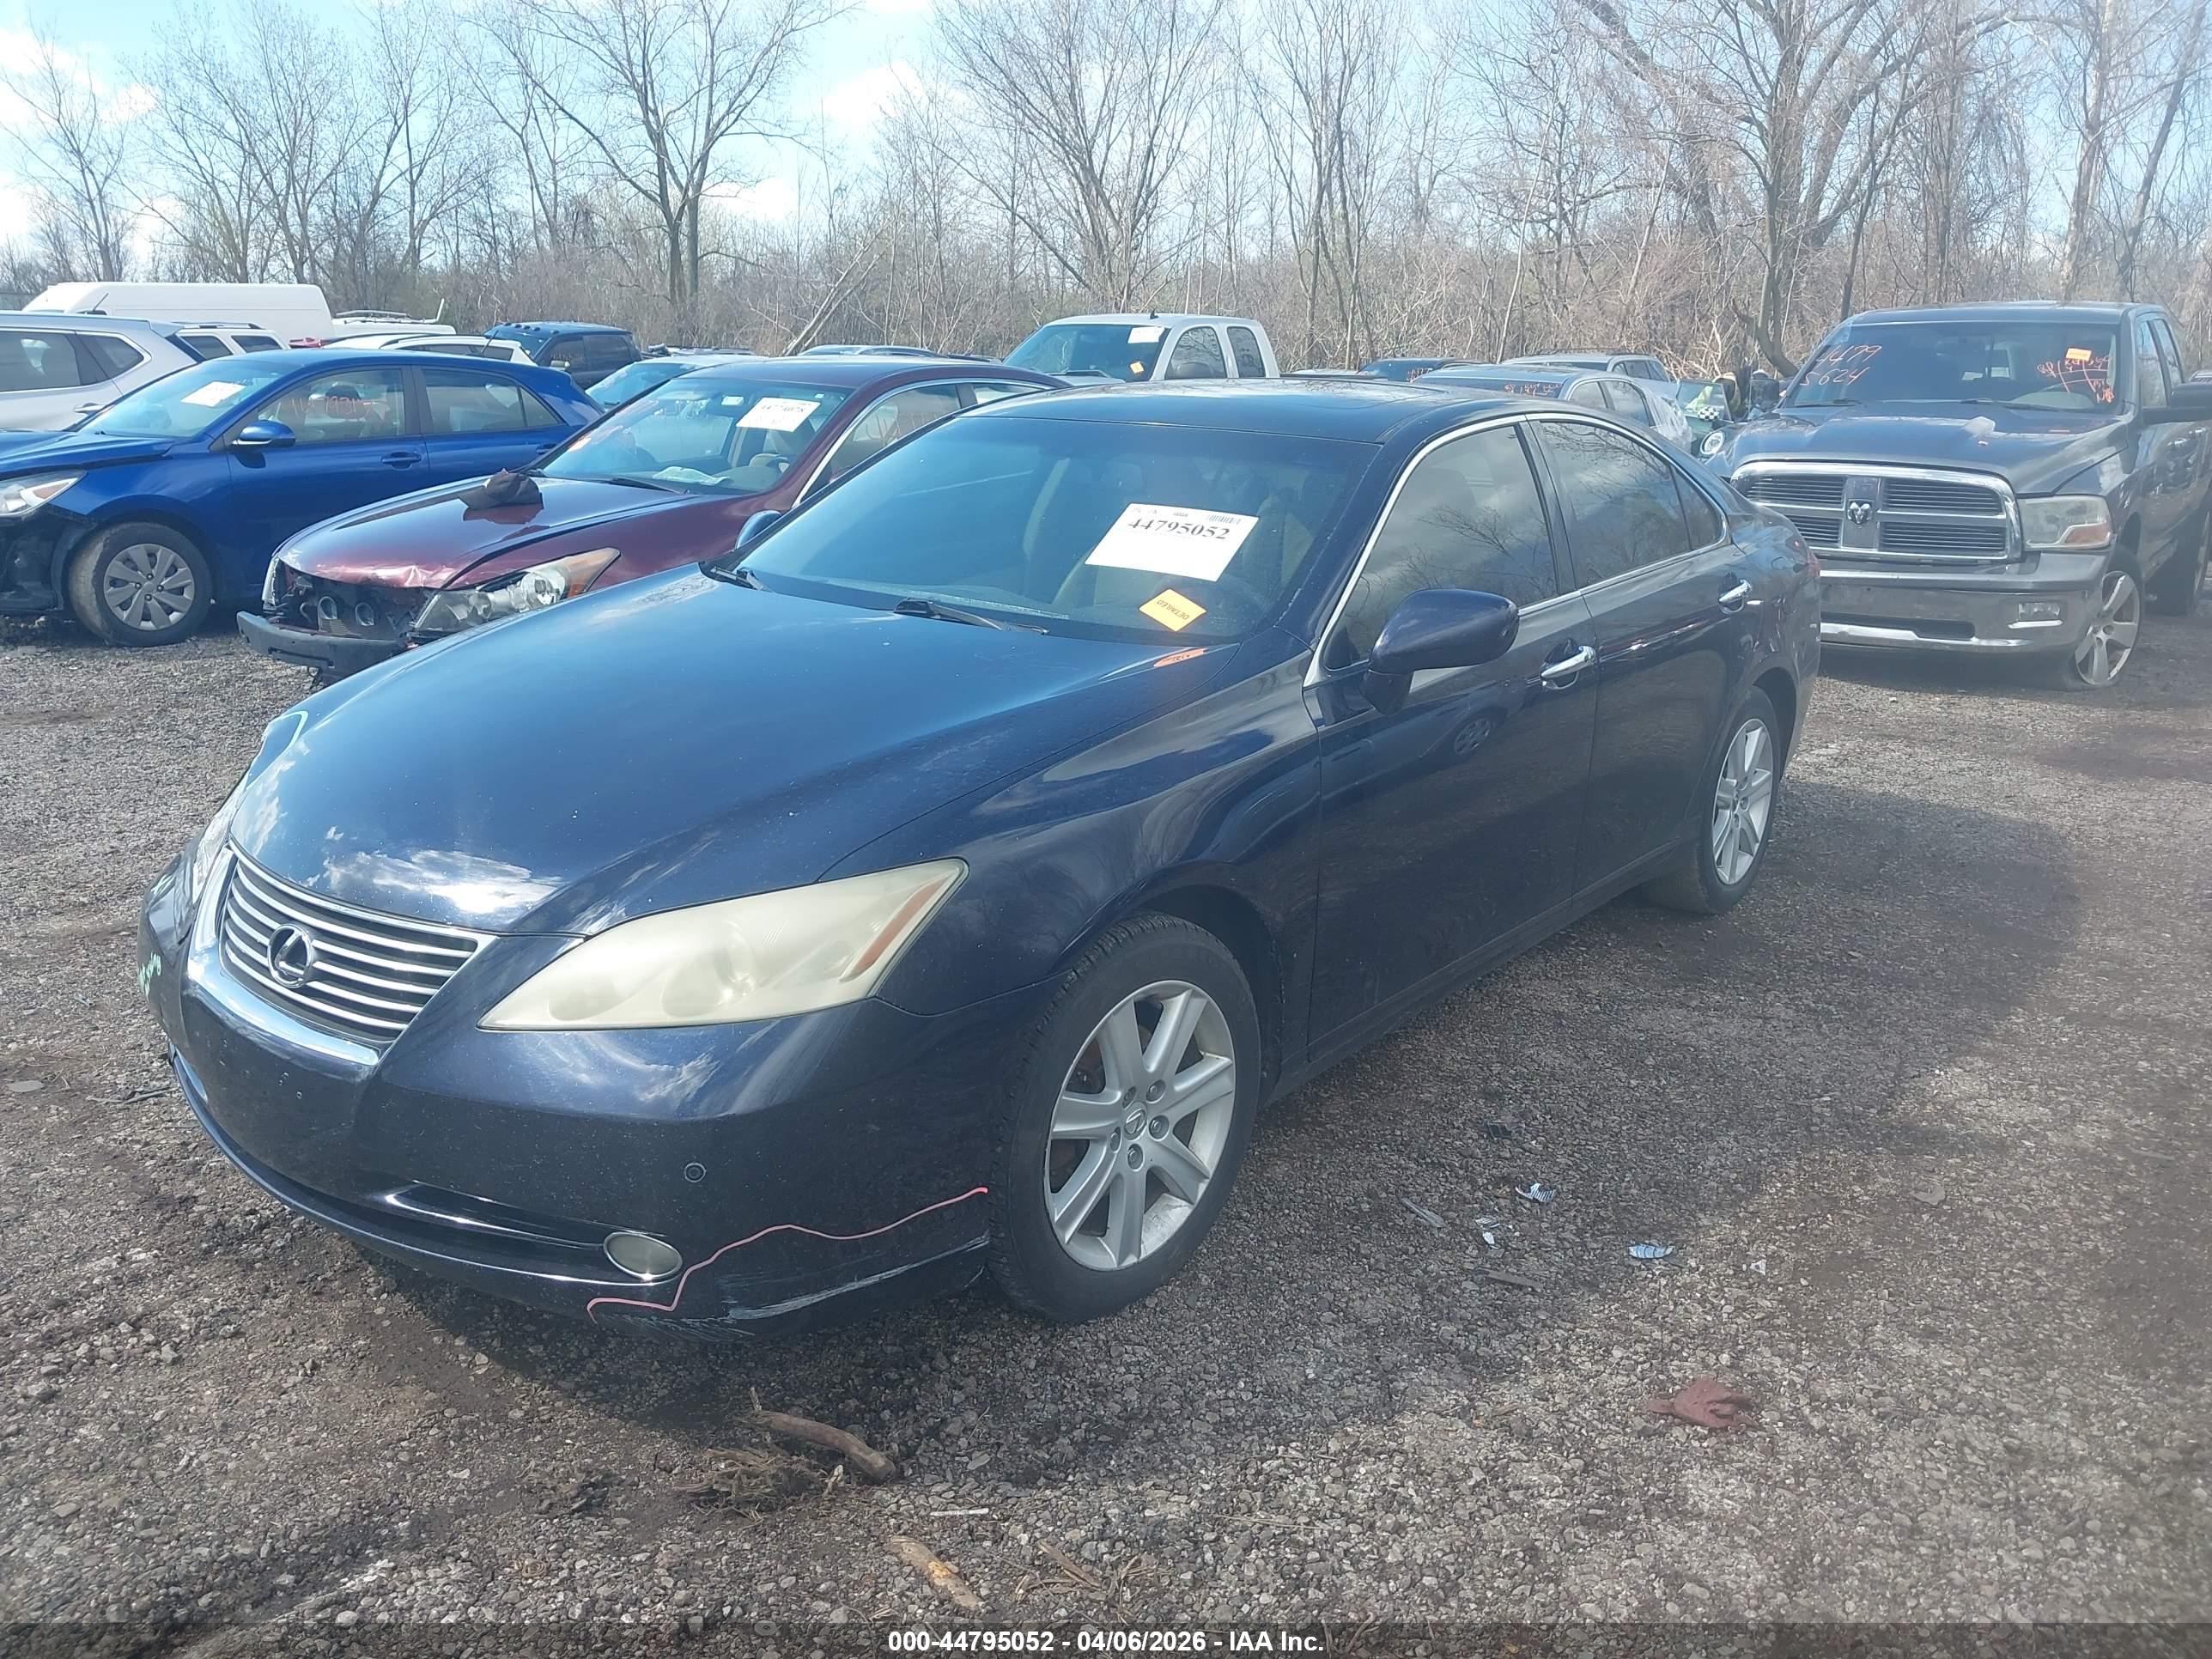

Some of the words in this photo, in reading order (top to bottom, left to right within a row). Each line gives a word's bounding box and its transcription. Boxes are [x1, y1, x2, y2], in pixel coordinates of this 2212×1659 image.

[1814, 344, 1882, 369] 4479
[1799, 366, 1870, 386] 5624
[1127, 518, 1231, 539] 44795052
[1156, 599, 1190, 621] DETAILED
